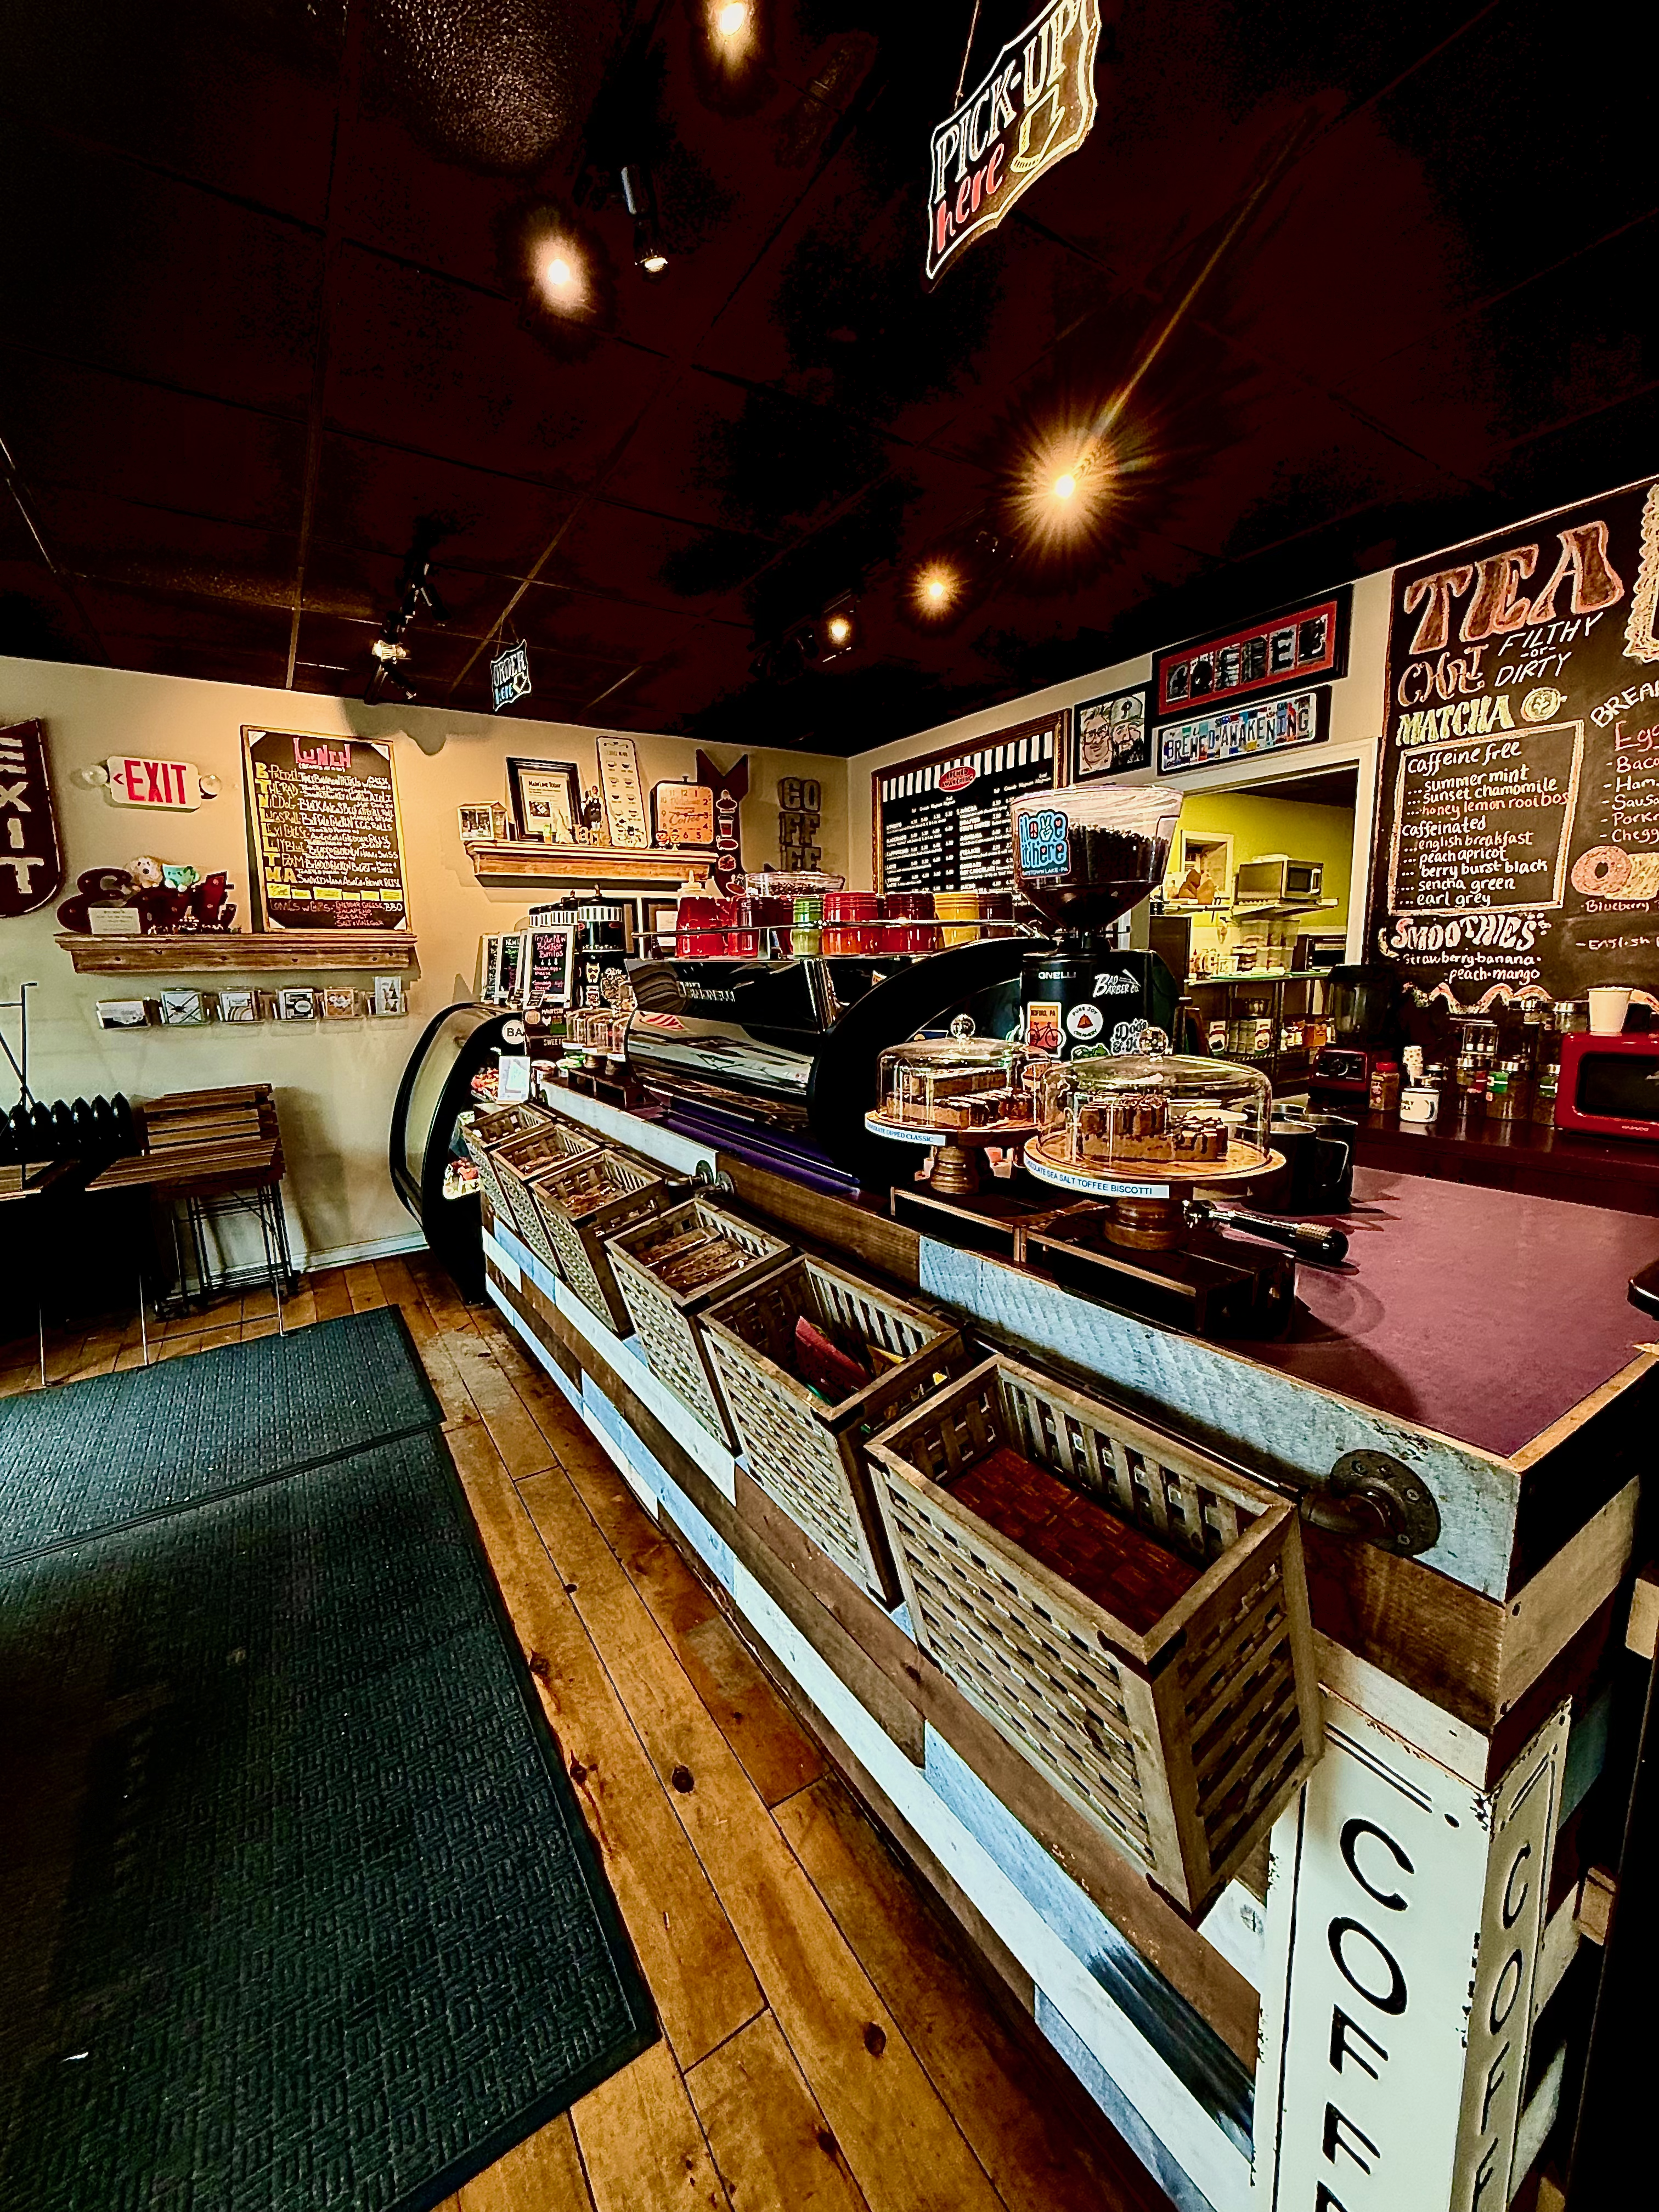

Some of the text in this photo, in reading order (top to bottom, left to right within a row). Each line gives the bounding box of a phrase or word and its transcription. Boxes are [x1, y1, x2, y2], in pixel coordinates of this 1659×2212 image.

[934, 0, 1079, 204] PICK-UP
[936, 143, 1005, 254] here
[1404, 521, 1625, 654] TEA
[1498, 612, 1603, 656] FILTHY
[494, 650, 527, 687] ORDER
[1494, 652, 1572, 687] DIRTY
[1396, 695, 1515, 746] MATCHA
[1482, 741, 1522, 766] free
[124, 760, 187, 804] EXIT
[1488, 764, 1530, 783] mint
[1474, 777, 1558, 799] chamomile
[1464, 798, 1506, 814] lemon
[1464, 830, 1534, 848] breakfast
[1457, 846, 1509, 864] apricot
[1461, 861, 1502, 876] burst
[1504, 858, 1548, 874] black
[1470, 877, 1516, 895] green
[1454, 893, 1491, 907] grey
[1390, 913, 1537, 951] SMOOTHIES
[1072, 1006, 1098, 1017] PURE JOY
[886, 1129, 905, 1138] DIPPED
[906, 1133, 934, 1143] CLASSIC
[1047, 1170, 1058, 1180] SEA
[1059, 1174, 1076, 1186] SALT
[1076, 1178, 1109, 1192] TOFFEE
[1111, 1184, 1153, 1195] BISCOTTI
